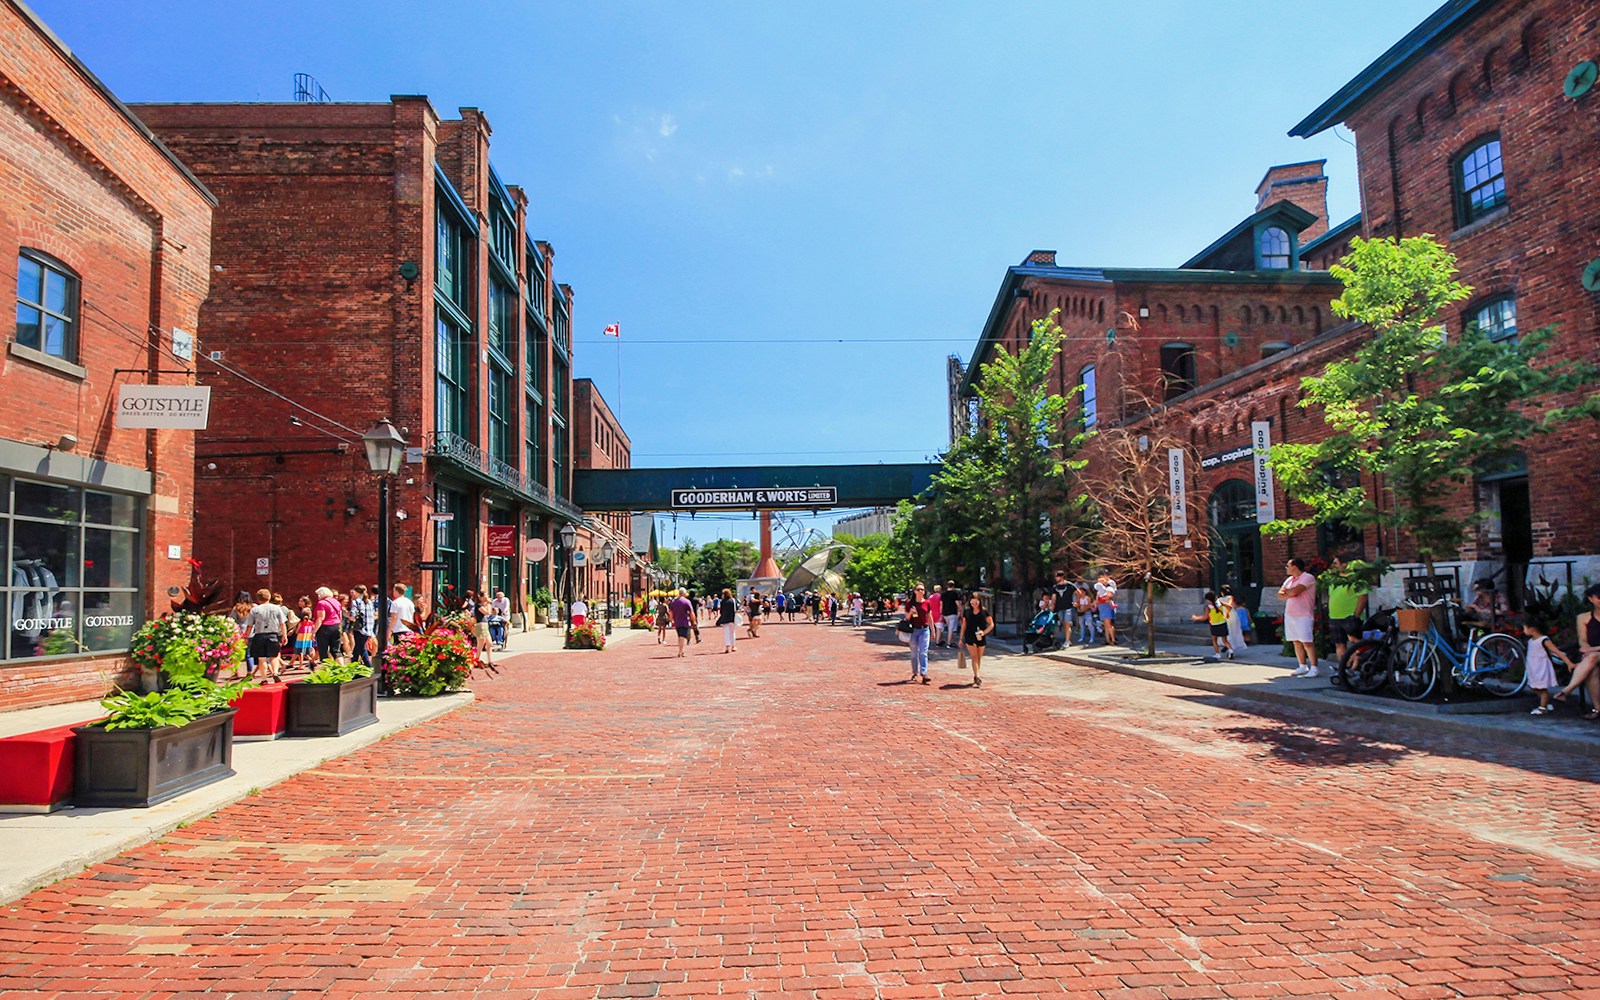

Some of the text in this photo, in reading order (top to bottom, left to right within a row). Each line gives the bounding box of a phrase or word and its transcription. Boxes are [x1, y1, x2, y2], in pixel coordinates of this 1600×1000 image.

[122, 397, 203, 412] GOTSTYLE
[1202, 448, 1252, 467] cop. copine
[679, 492, 753, 504] GOODERHAM
[756, 491, 767, 502] &
[766, 490, 807, 502] WORTS
[15, 617, 73, 631] GOTSTYLE
[85, 615, 134, 627] GOTSTYLE
